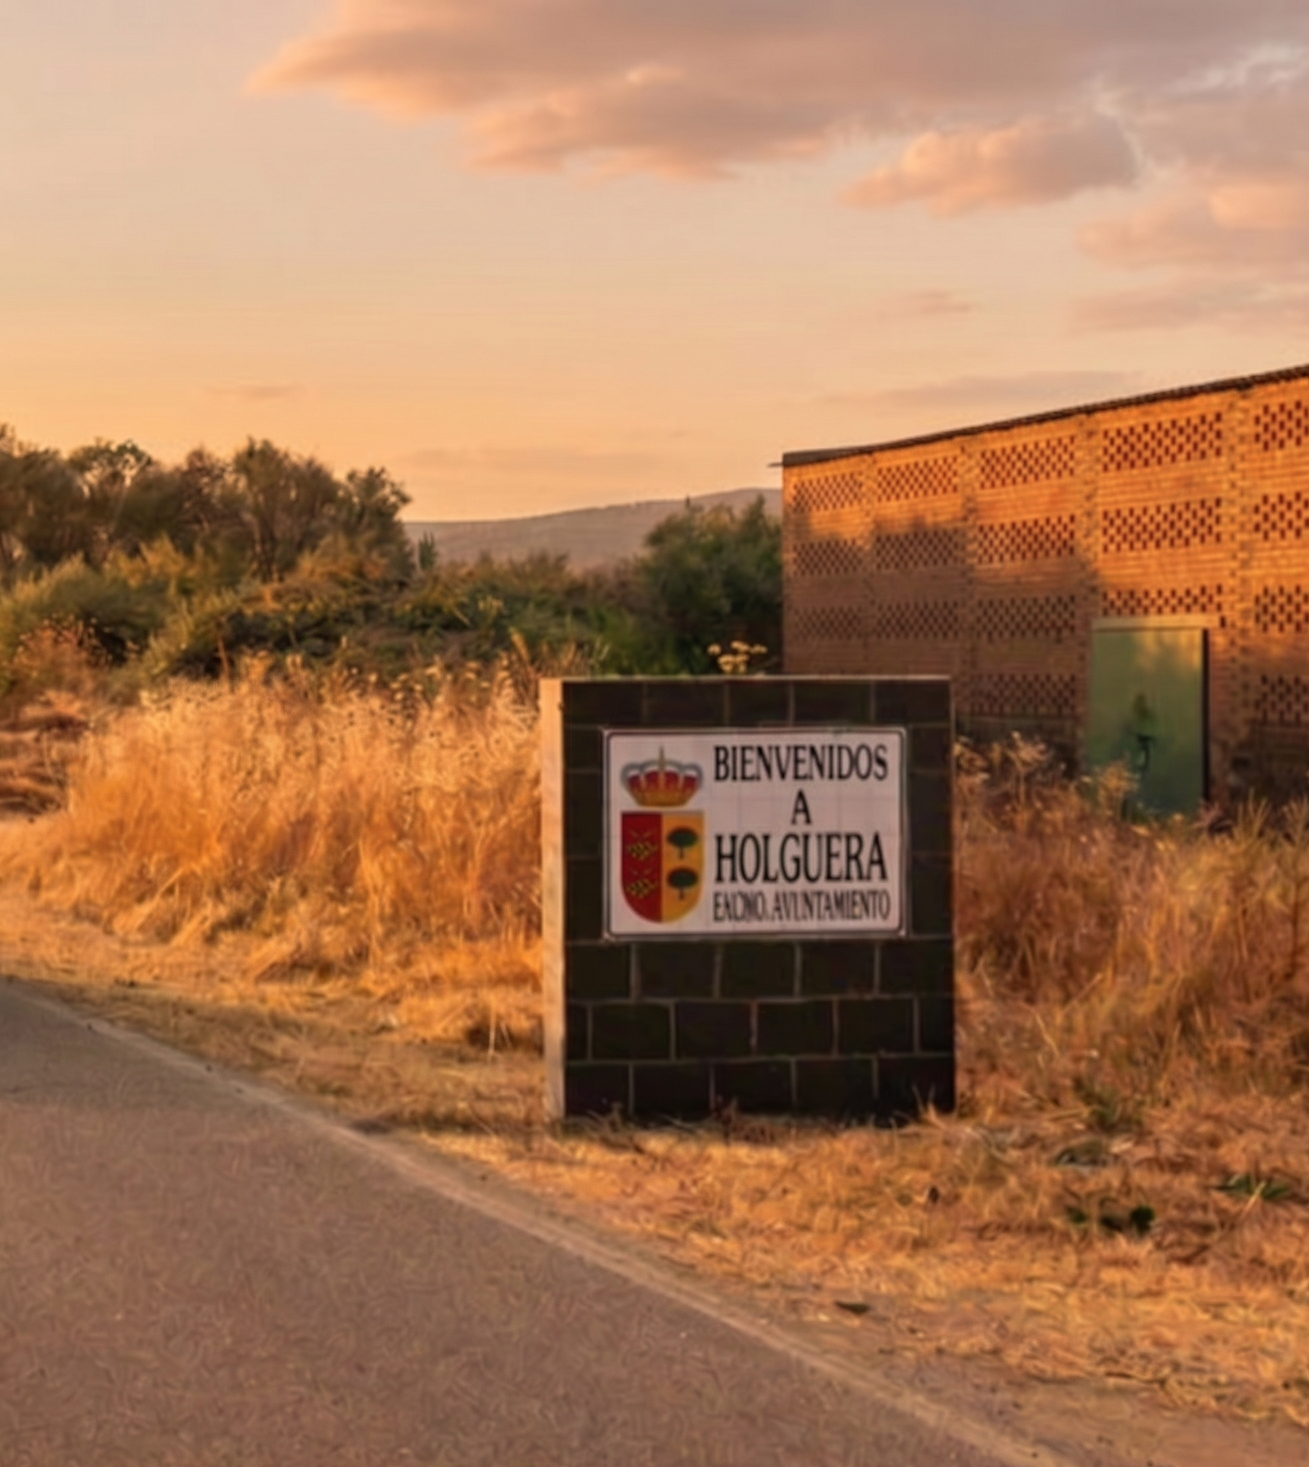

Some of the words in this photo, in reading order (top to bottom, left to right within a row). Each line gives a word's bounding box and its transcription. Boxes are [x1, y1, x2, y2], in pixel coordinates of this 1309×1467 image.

[714, 744, 888, 782] BIENVENIDOS
[791, 789, 812, 825] A
[715, 831, 888, 883] HOLGUERA
